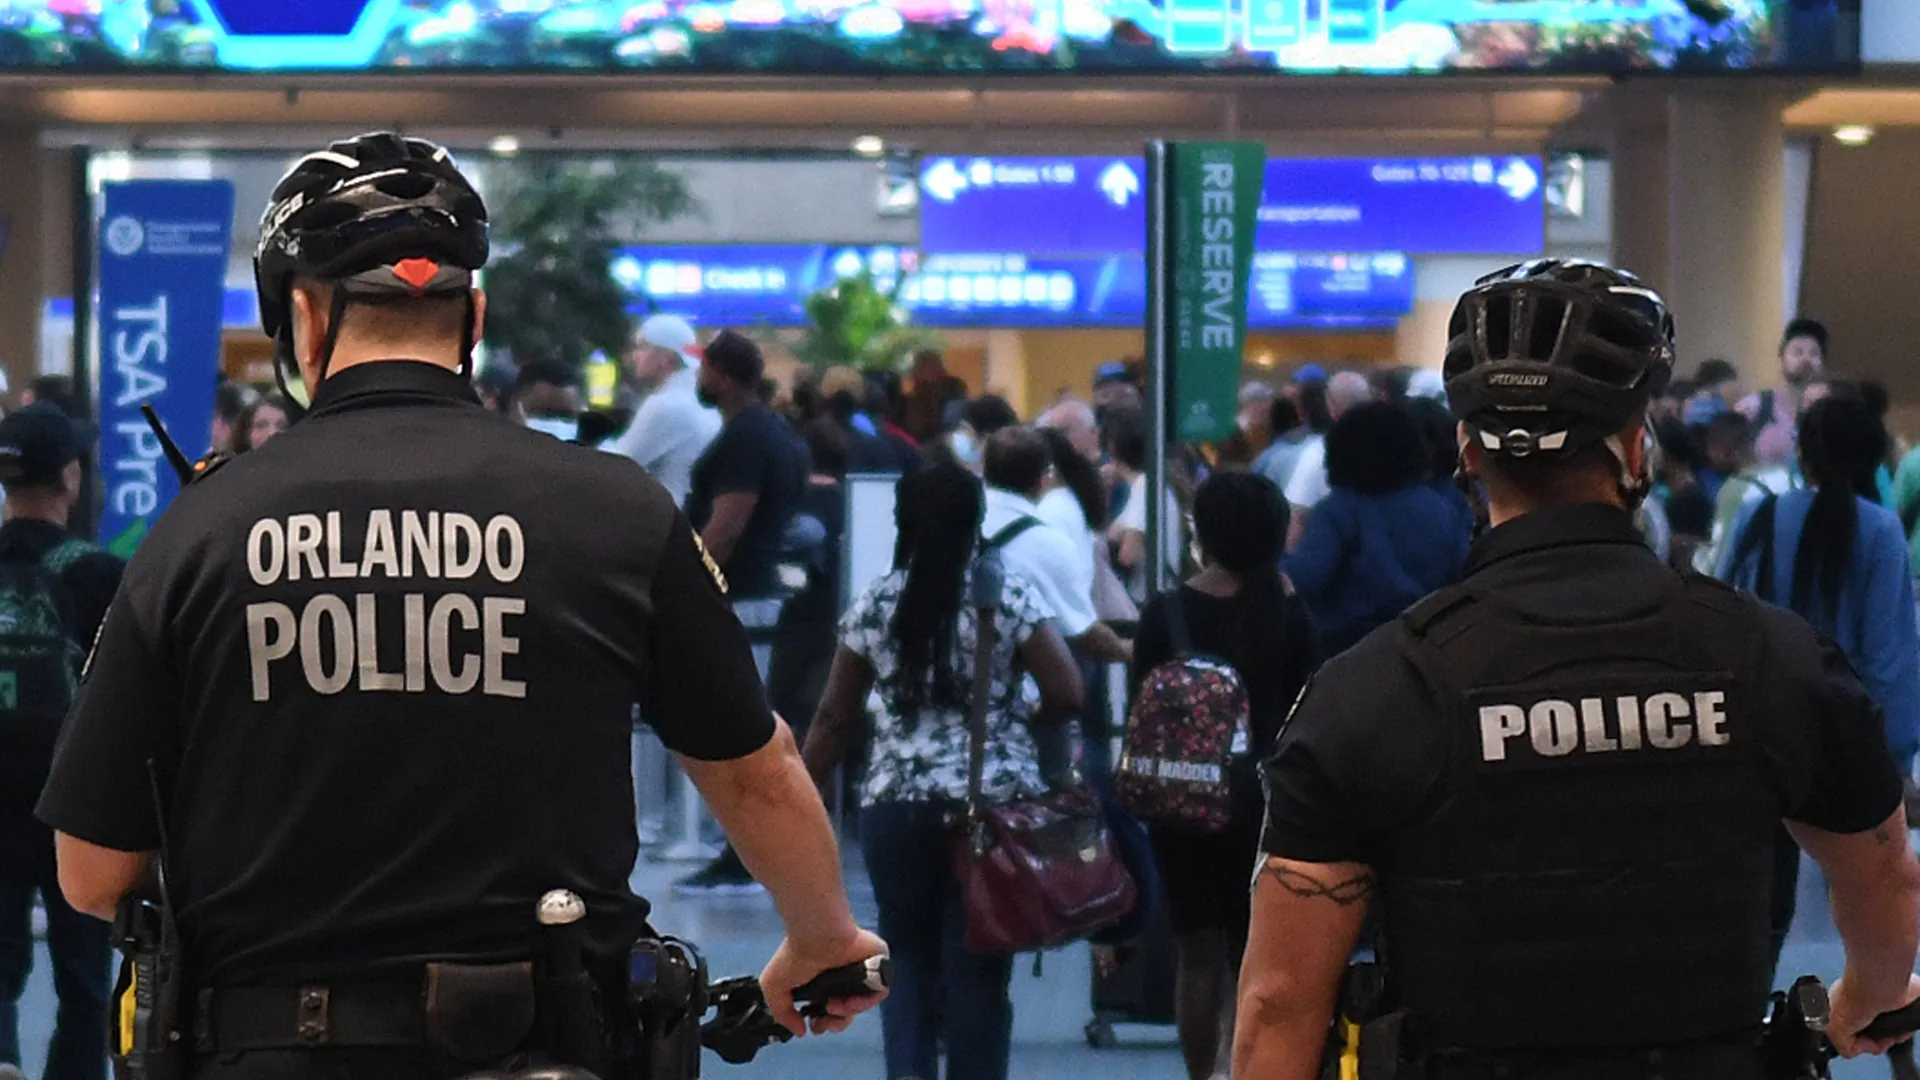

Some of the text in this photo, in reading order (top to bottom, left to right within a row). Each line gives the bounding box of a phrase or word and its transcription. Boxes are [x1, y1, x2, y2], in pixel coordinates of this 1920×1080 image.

[1202, 163, 1234, 349] RESERVE
[1256, 206, 1360, 222] ransportation
[115, 295, 168, 517] TSA Pre
[247, 509, 525, 586] ORLANDO
[246, 592, 527, 701] POLICE
[1479, 691, 1731, 761] POLICE
